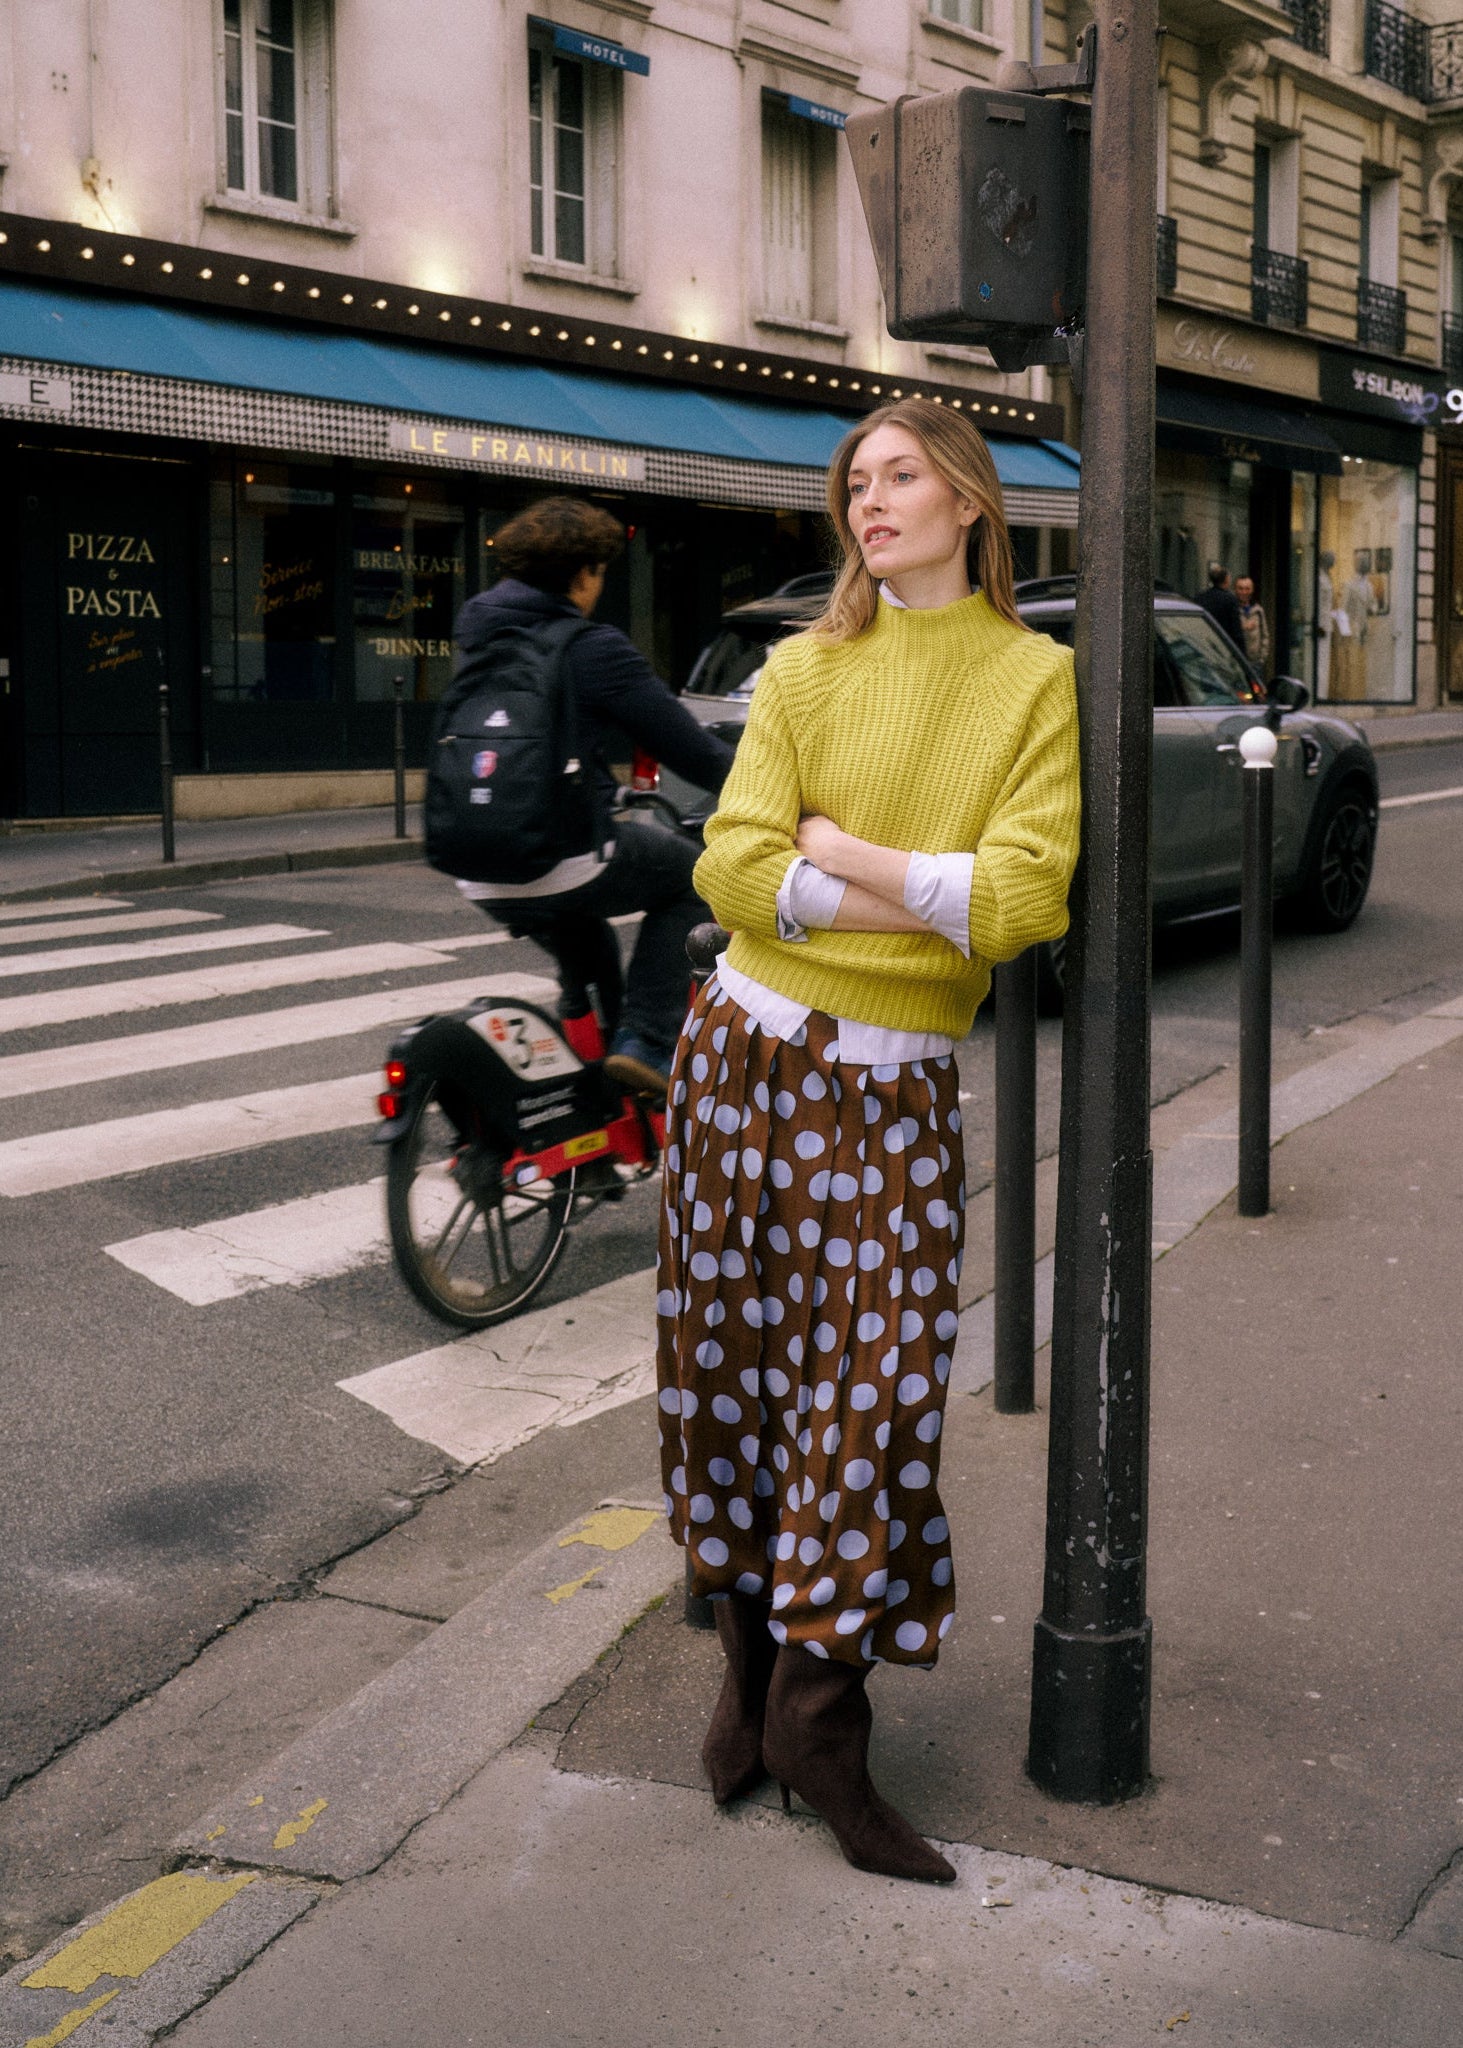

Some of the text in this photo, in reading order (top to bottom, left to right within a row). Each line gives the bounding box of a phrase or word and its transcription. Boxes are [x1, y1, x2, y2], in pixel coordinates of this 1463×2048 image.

[582, 41, 627, 65] HOTEL
[1366, 372, 1423, 405] SILBON
[410, 428, 628, 477] LE FRANKLIN
[67, 532, 155, 563] PIZZA
[107, 567, 120, 581] &
[359, 550, 463, 574] BREAKFAST
[66, 586, 161, 618] PASTA
[375, 636, 452, 657] DINNER
